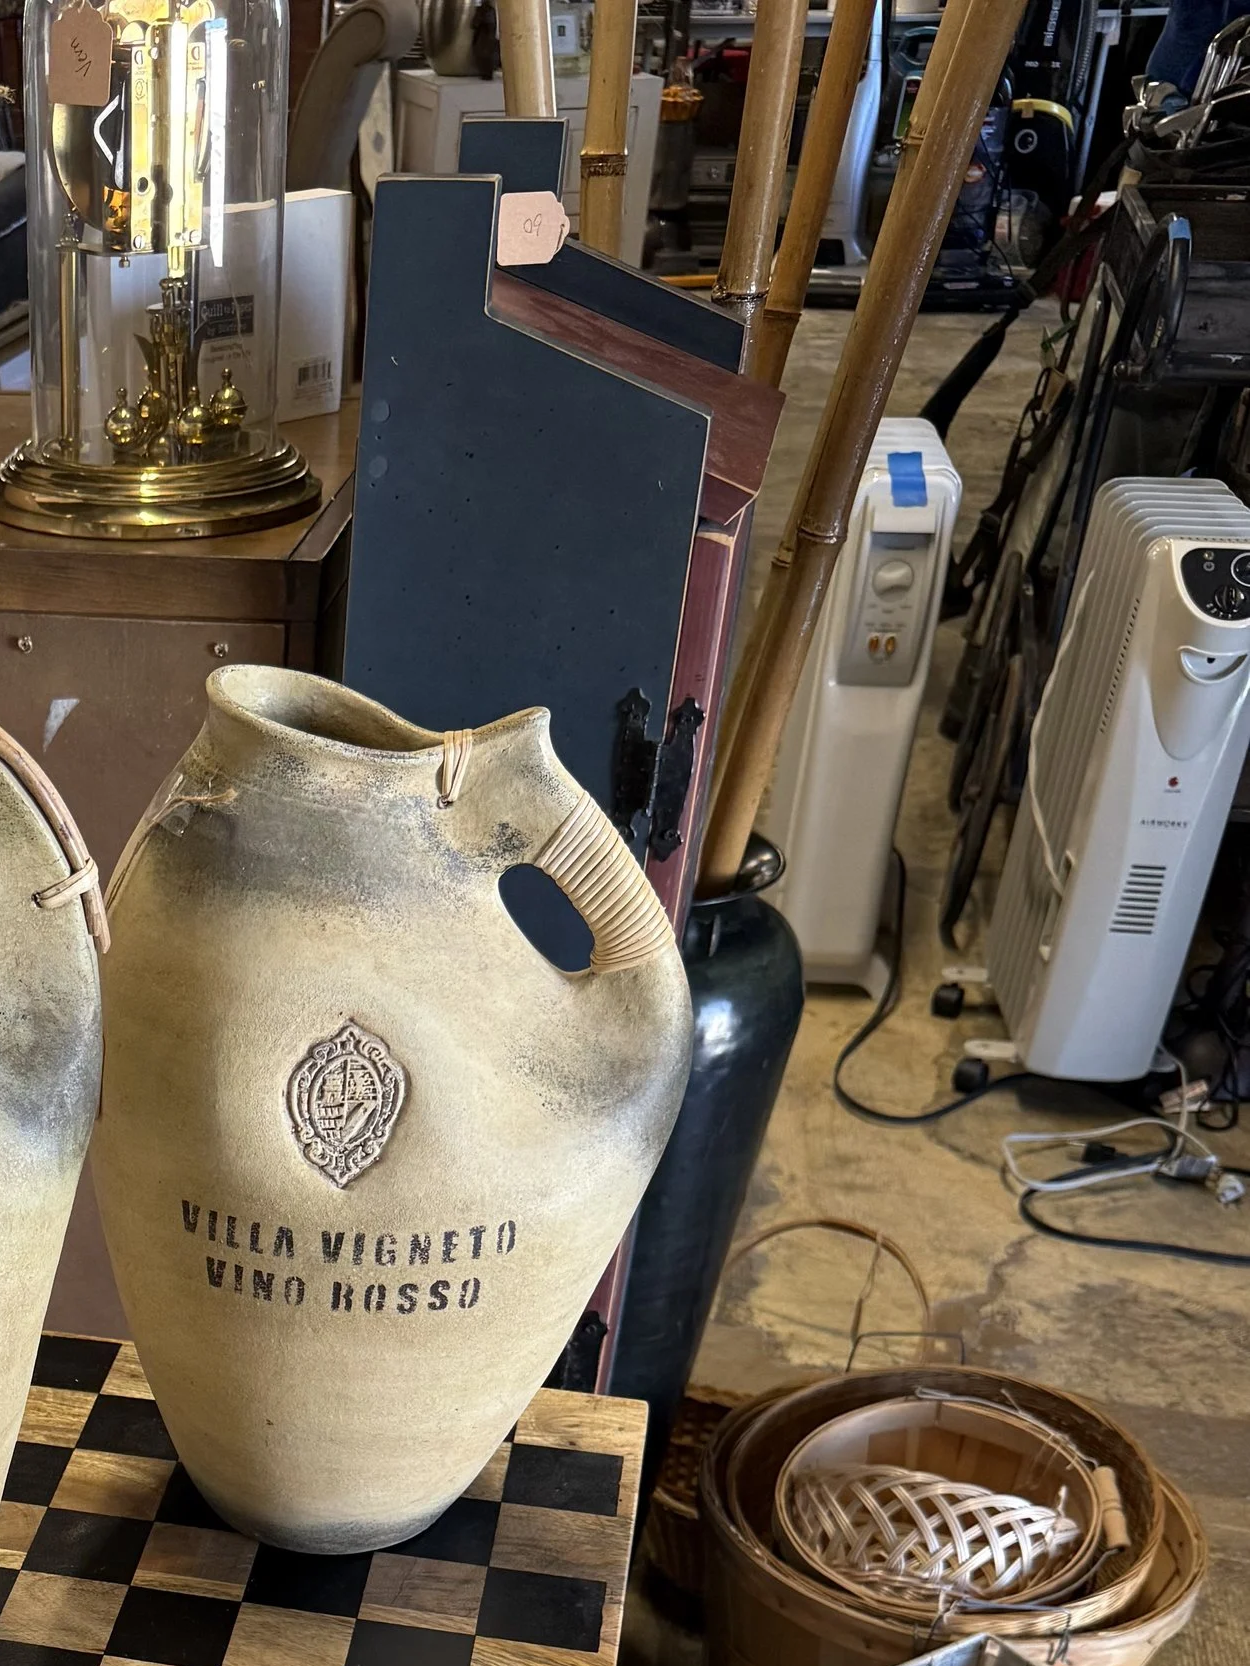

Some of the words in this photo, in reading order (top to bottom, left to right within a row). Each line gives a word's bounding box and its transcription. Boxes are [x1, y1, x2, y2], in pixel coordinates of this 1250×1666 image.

[70, 36, 92, 77] Vern
[181, 1199, 295, 1260] VILLA
[320, 1219, 518, 1267] VIGNETO
[205, 1256, 306, 1306] VINO
[331, 1276, 482, 1315] ROSSO
